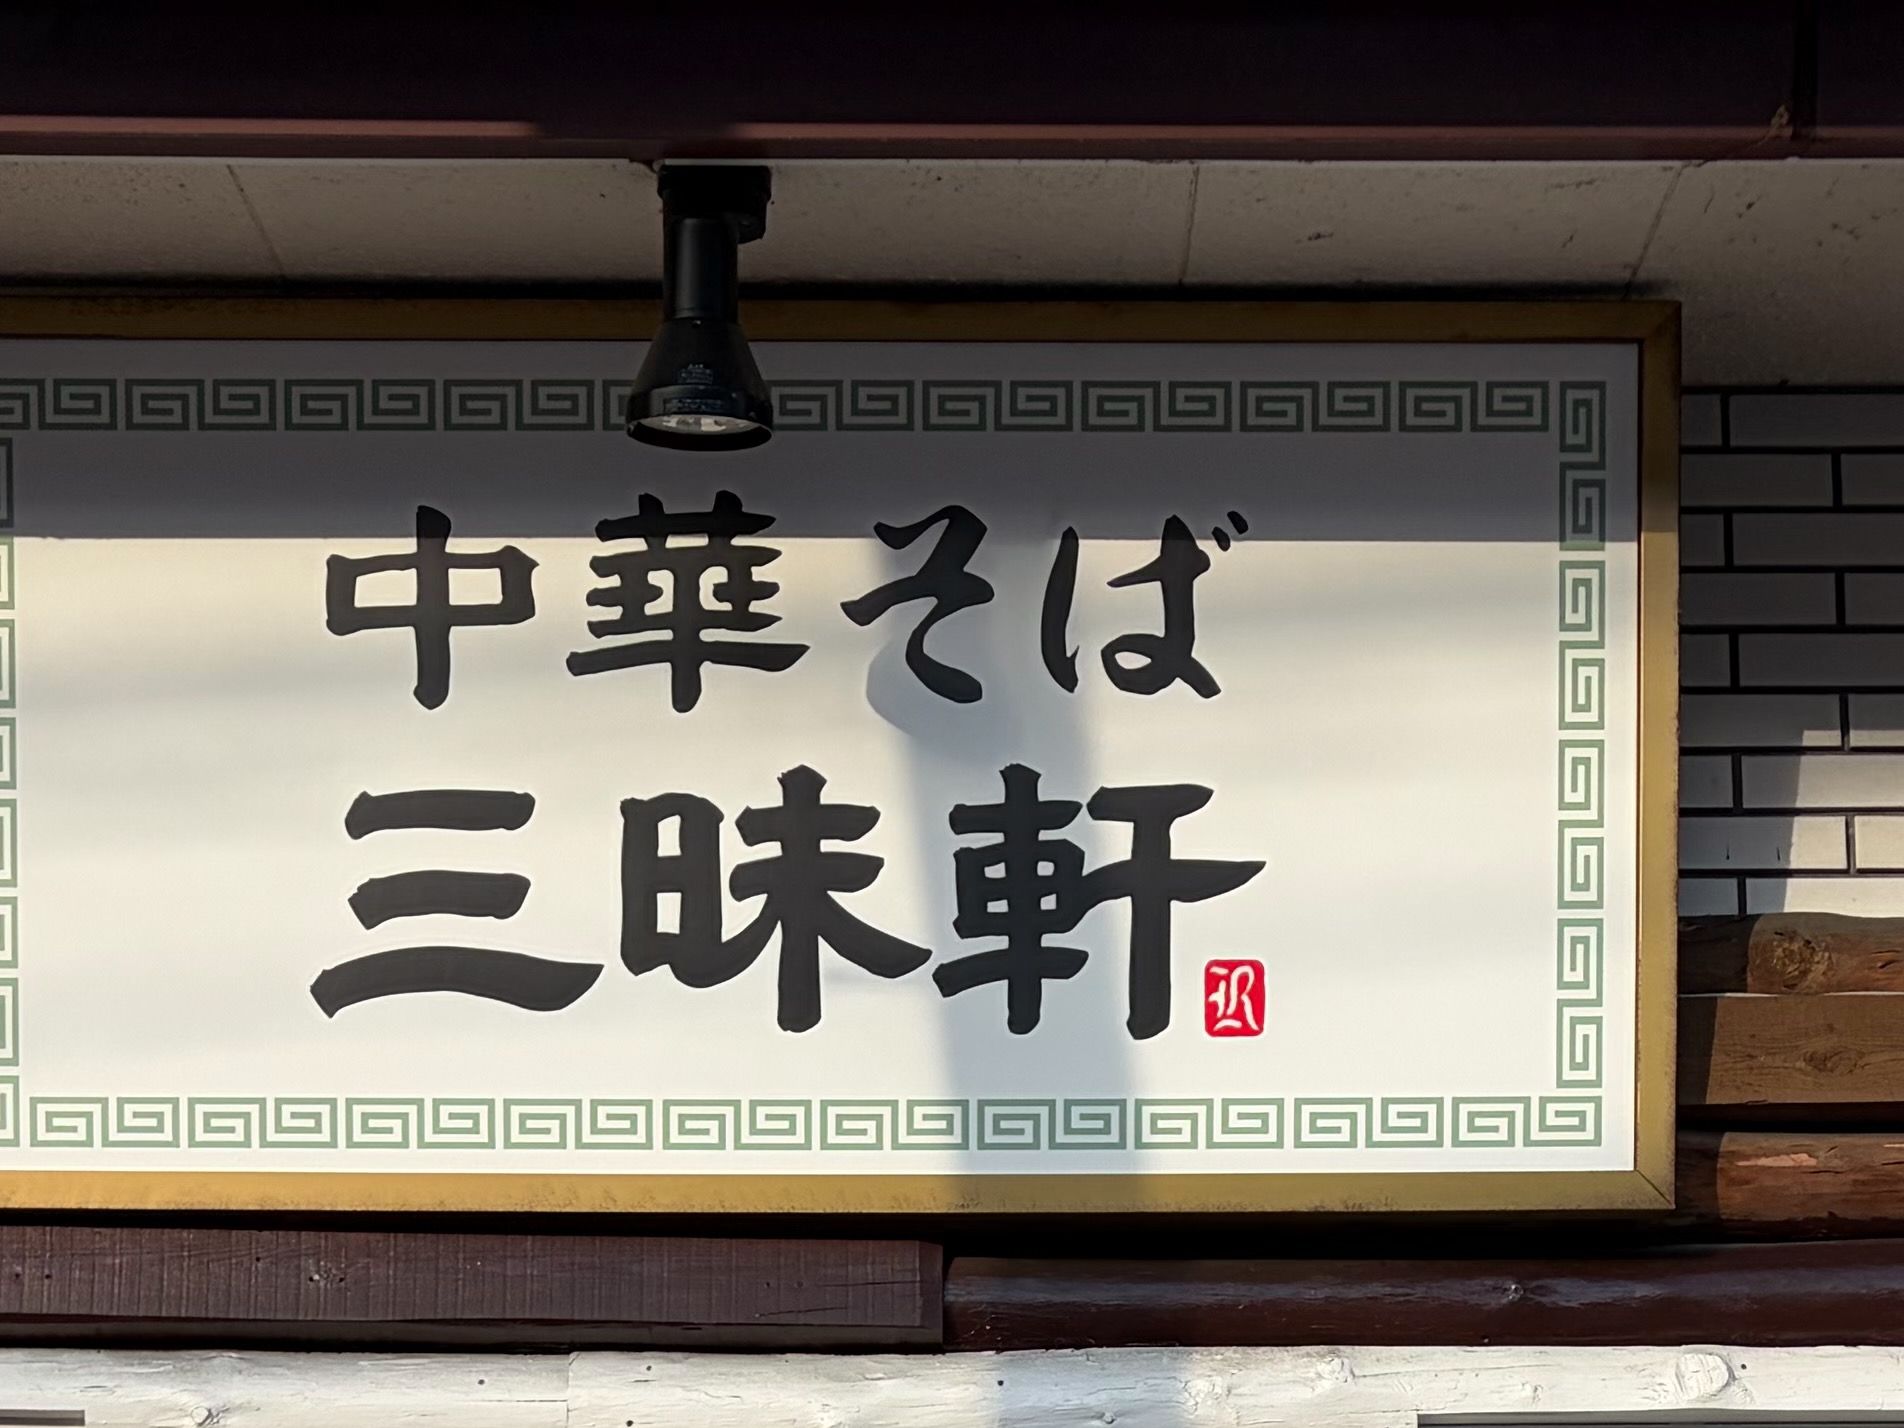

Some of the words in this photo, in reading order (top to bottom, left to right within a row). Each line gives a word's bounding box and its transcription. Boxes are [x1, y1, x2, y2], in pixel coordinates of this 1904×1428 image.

[326, 491, 1249, 712] 中華そば
[310, 764, 1266, 1039] 三昧軒
